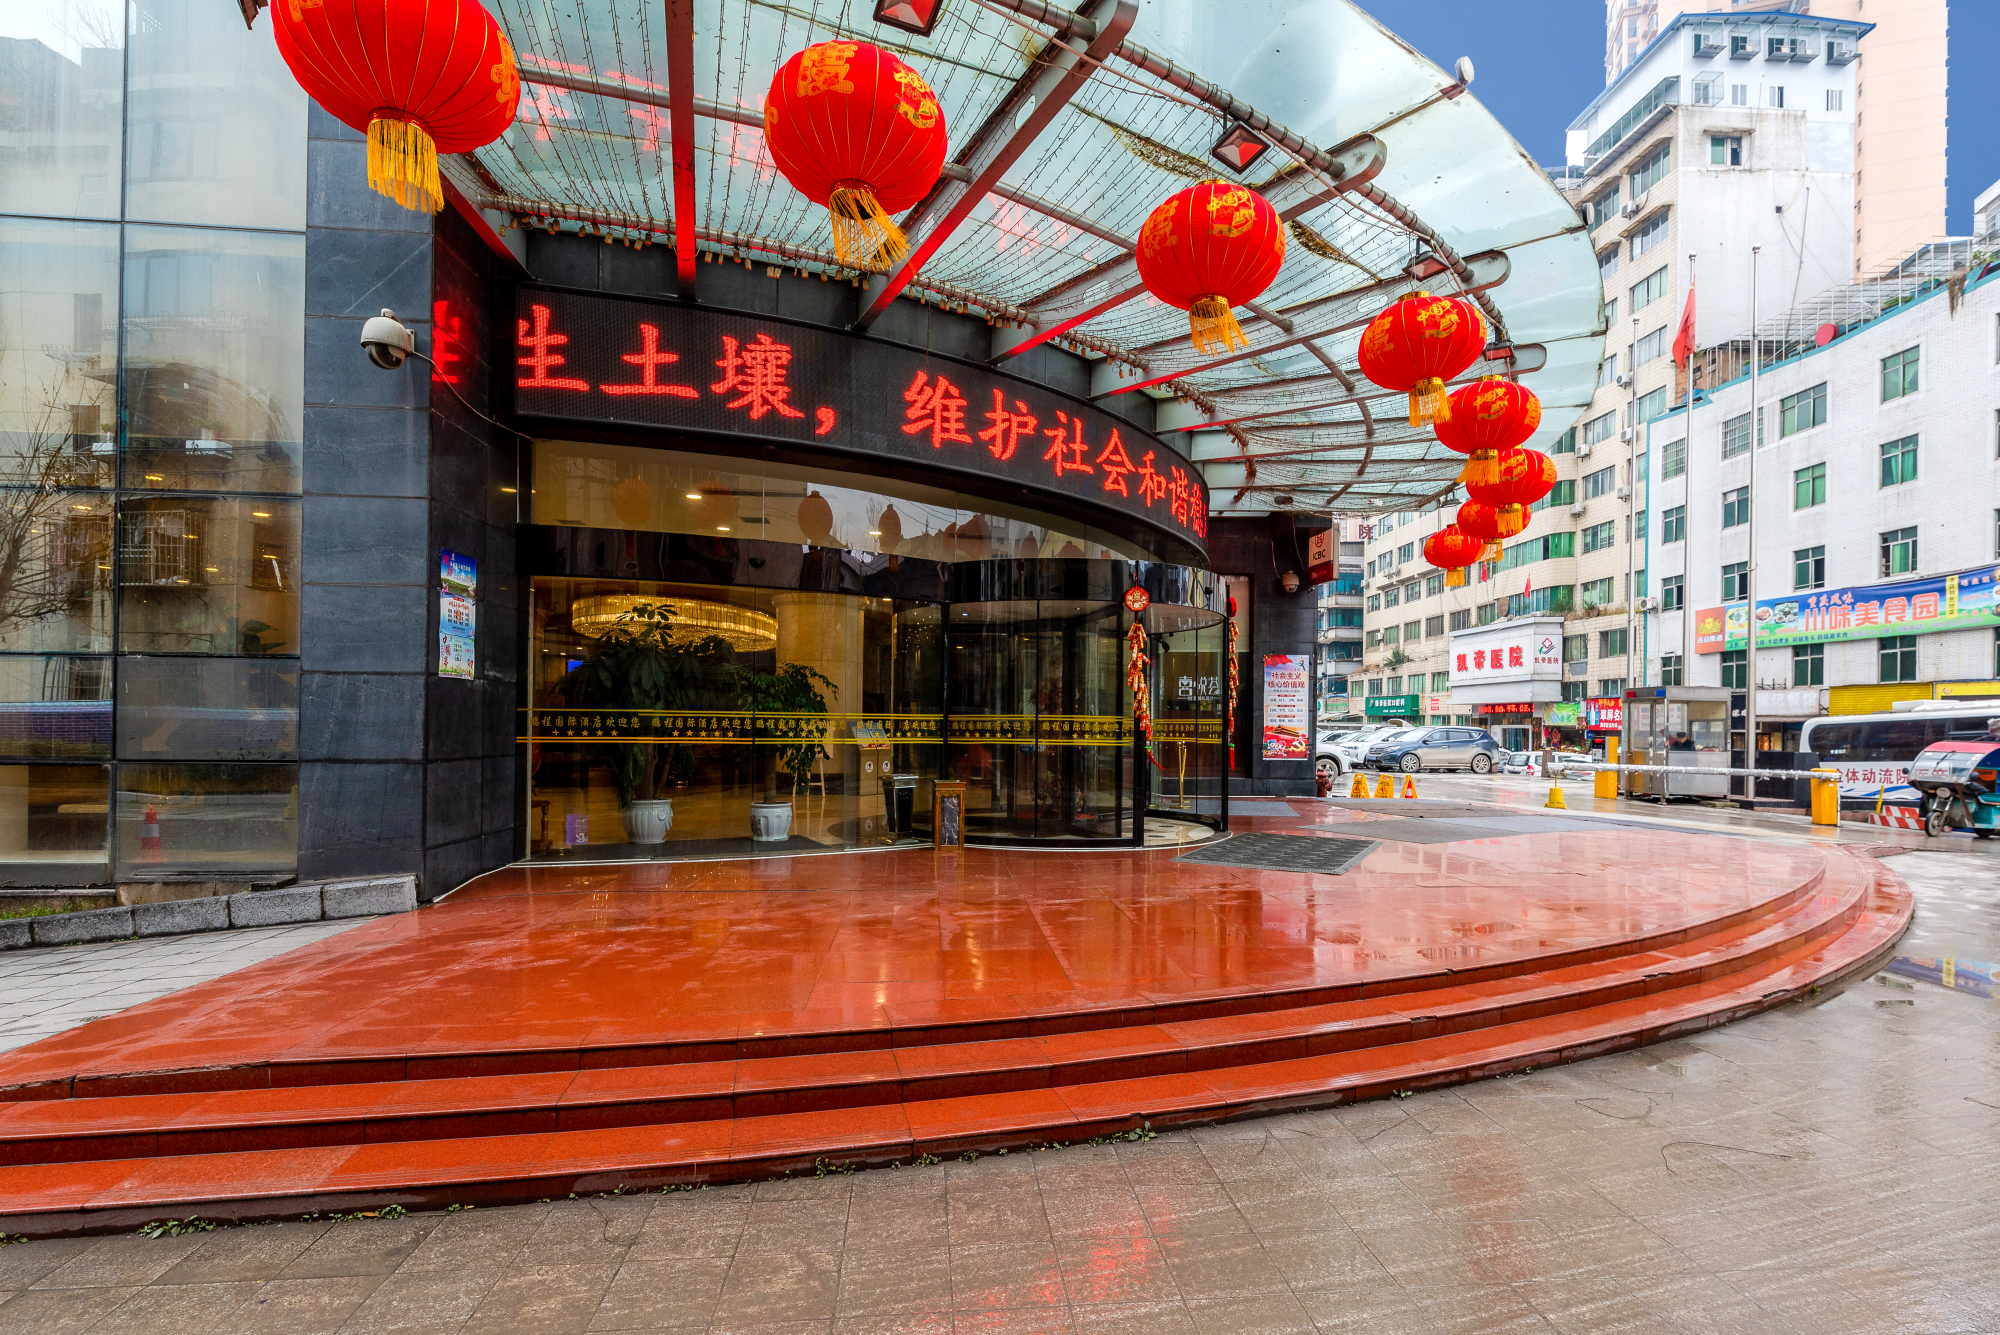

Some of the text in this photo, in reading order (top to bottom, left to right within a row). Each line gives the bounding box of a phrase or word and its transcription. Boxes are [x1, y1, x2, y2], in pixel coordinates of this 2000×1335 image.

[1359, 525, 1373, 539] 院
[1313, 549, 1326, 561] ICBC
[1807, 591, 1854, 609] 重庆风味
[1805, 592, 1940, 632] 川味美食园
[1457, 645, 1522, 672] 凯帝医院
[1534, 656, 1559, 664] 凯帝医院
[1272, 672, 1301, 680] 社会主义
[1600, 709, 1622, 721] 翠屏名
[530, 716, 640, 728] 鹏程国际酒店欢迎您
[652, 717, 752, 729] 鹏程国际酒店欢迎您
[857, 719, 936, 731] 鹏程国际店欢迎您
